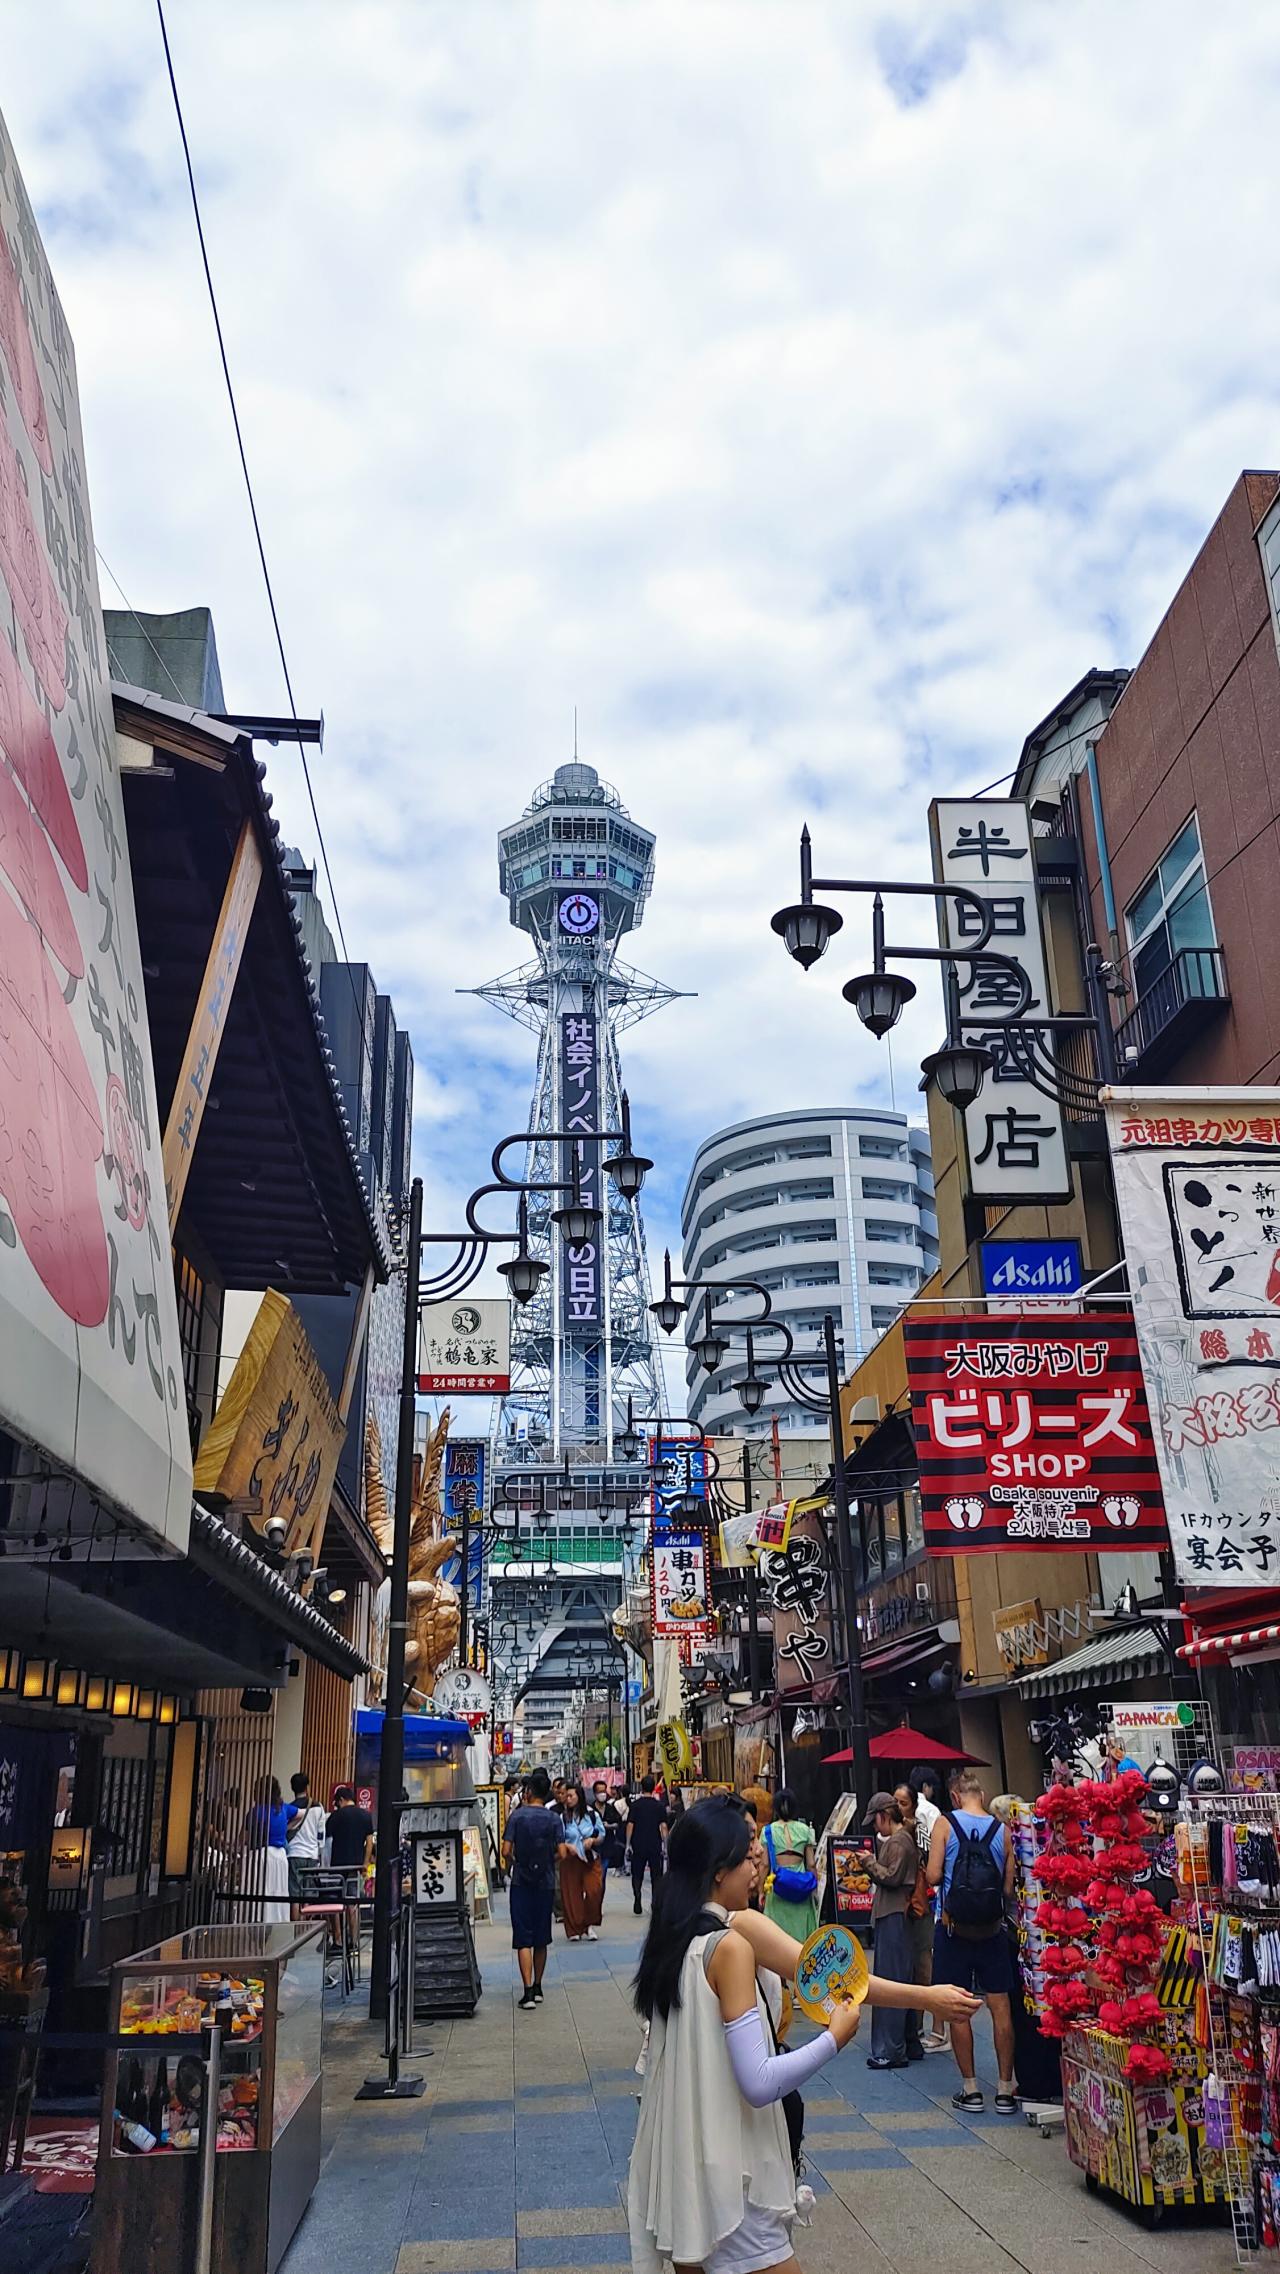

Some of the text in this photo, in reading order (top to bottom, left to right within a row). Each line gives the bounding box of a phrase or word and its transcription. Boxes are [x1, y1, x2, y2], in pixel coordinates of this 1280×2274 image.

[552, 934, 603, 946] HITACH
[991, 1255, 1073, 1288] Asahi
[946, 1342, 1108, 1378] 大阪みやげ
[432, 1377, 496, 1388] 24時間営業中
[930, 1388, 1137, 1449] ビリーズ
[1163, 1377, 1280, 1454] 大阪名
[447, 1446, 480, 1509] 麻雀
[991, 1453, 1087, 1478] SHOP
[991, 1486, 1099, 1501] Osaka souvenir
[1015, 1503, 1076, 1519] 大阪特产
[1008, 1520, 1090, 1537] 오사카특산물
[1185, 1533, 1278, 1572] 宴会予
[671, 1548, 697, 1603] 串カツ
[421, 1842, 444, 1900] ぎふや
